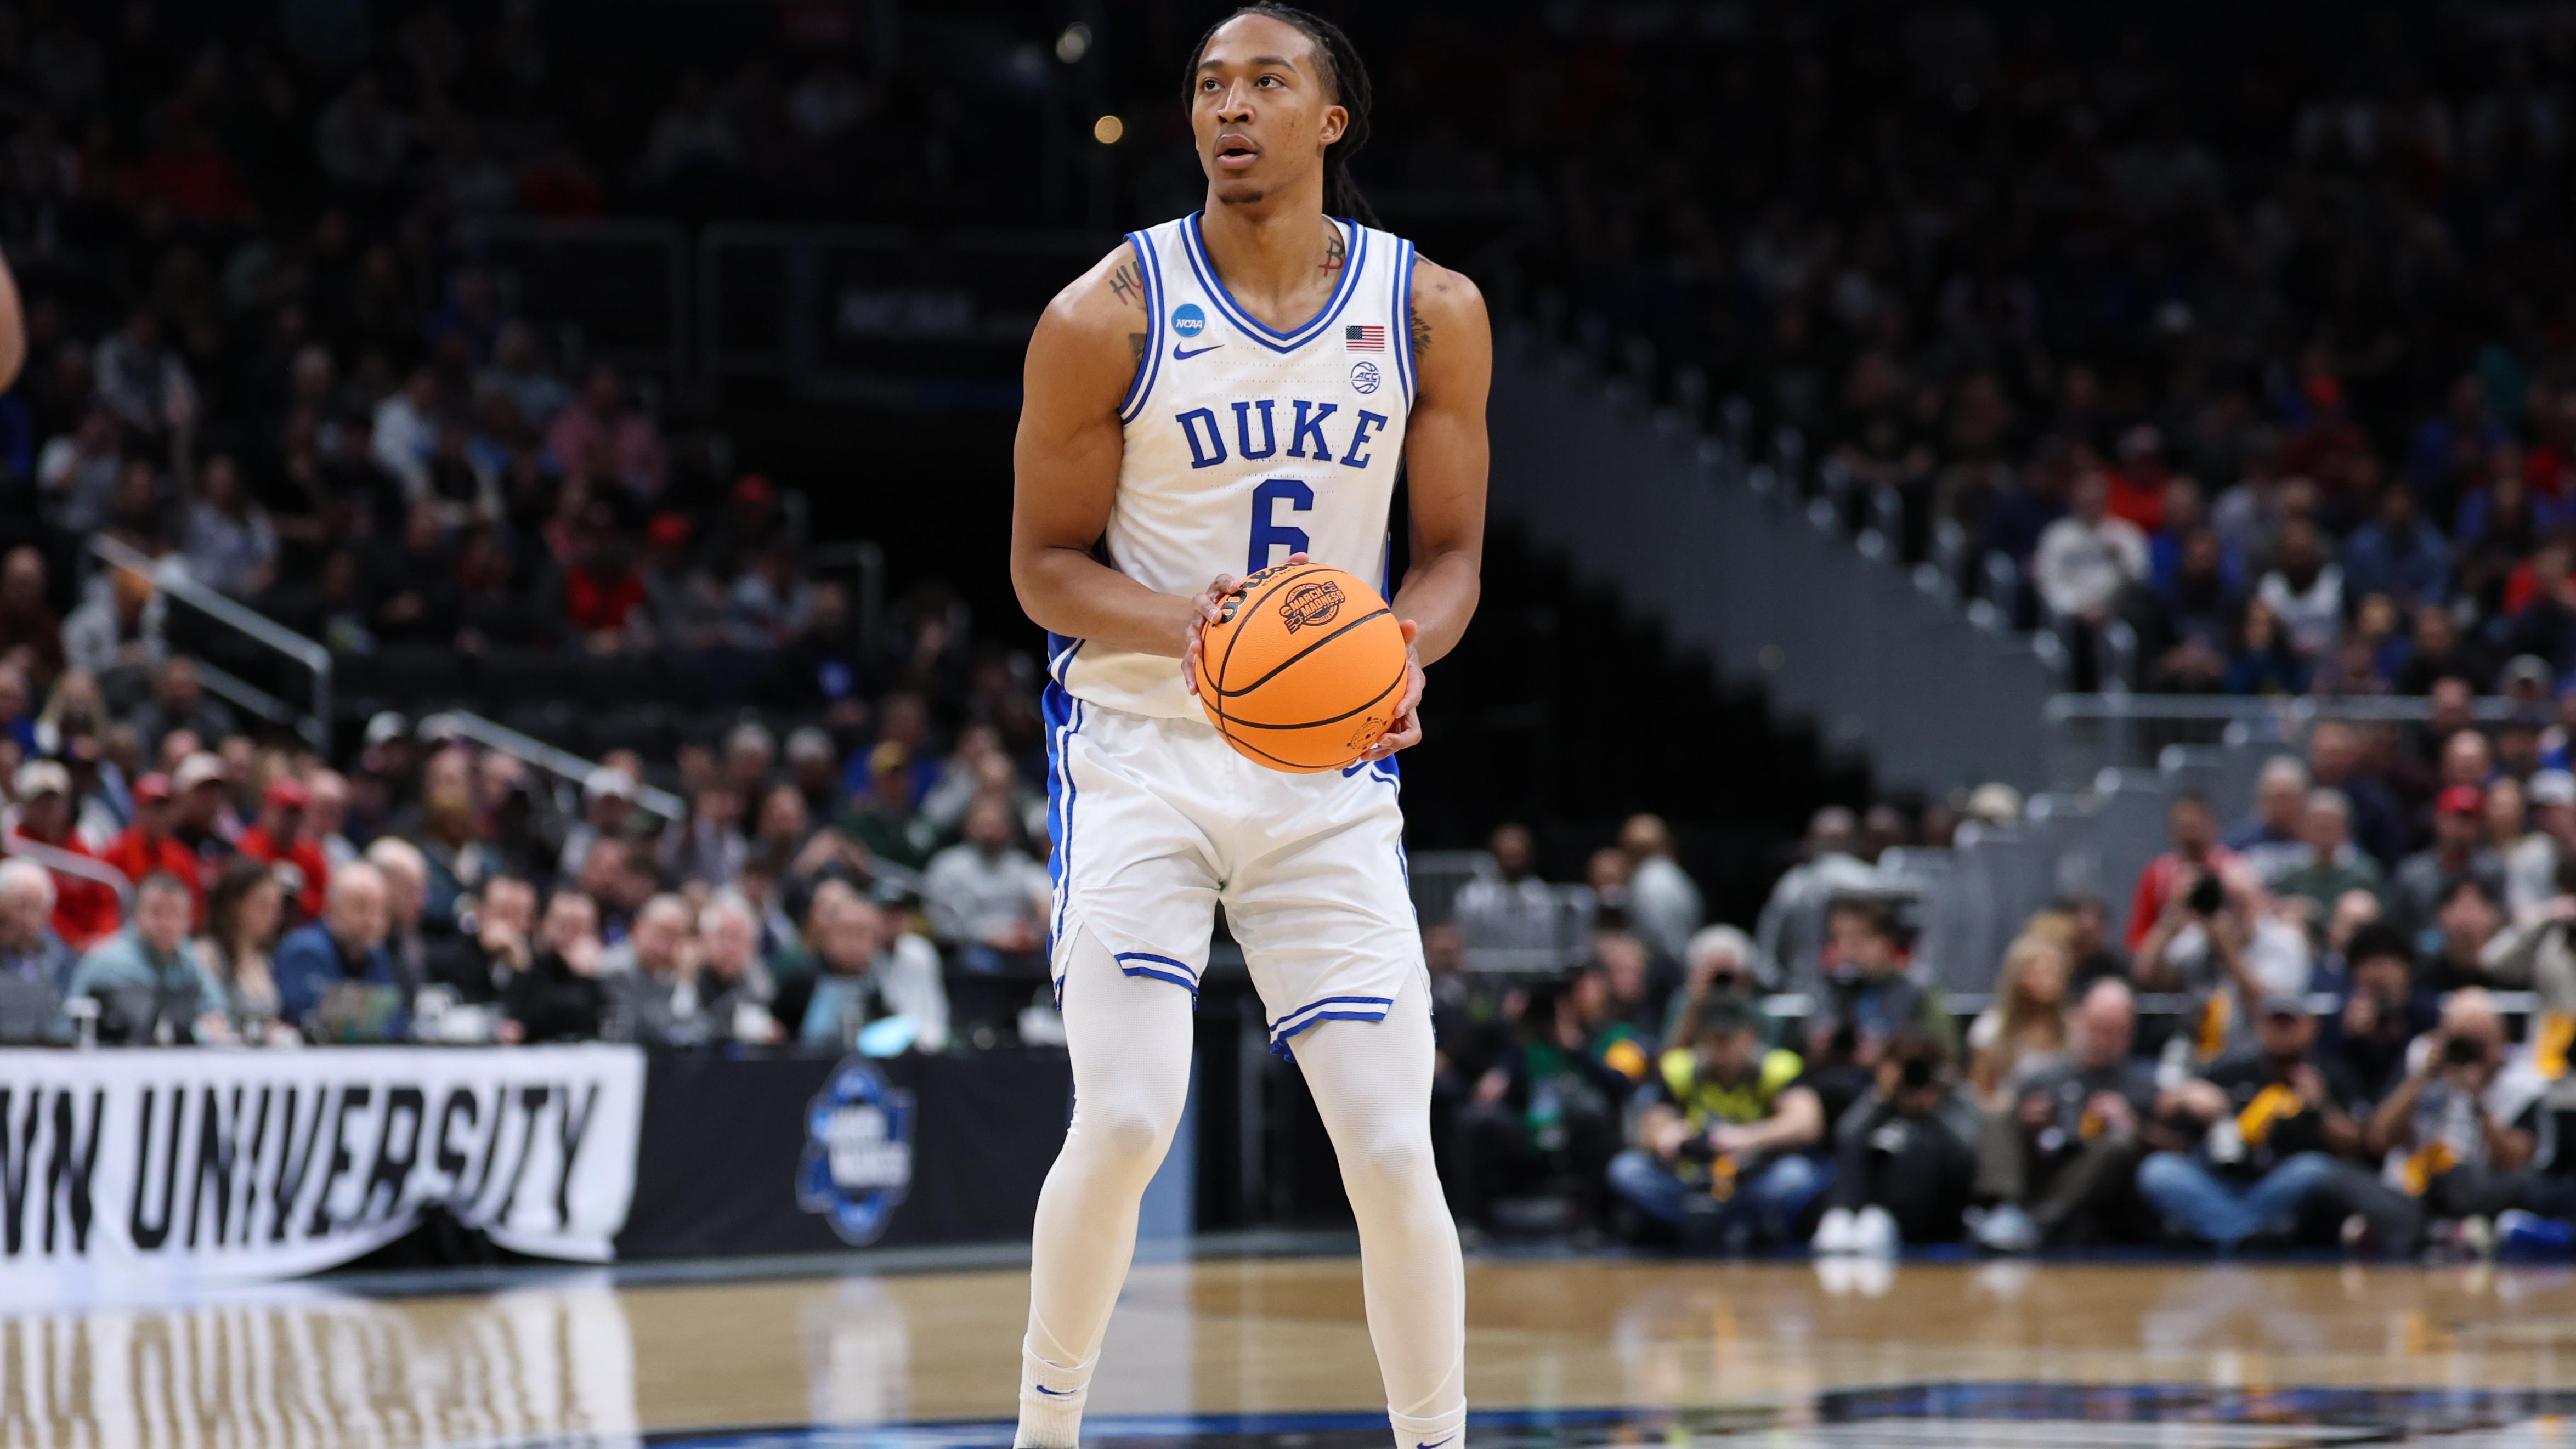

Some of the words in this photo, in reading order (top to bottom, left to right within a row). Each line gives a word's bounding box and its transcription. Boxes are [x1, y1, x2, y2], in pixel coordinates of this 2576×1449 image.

[1176, 319, 1203, 329] NCAA
[1355, 372, 1379, 381] ACC
[1175, 399, 1388, 470] DUKE
[1247, 479, 1314, 576] 6
[1289, 587, 1324, 612] MARCH
[1300, 590, 1345, 617] MADNESS
[131, 1084, 599, 1250] UNIVERSITY
